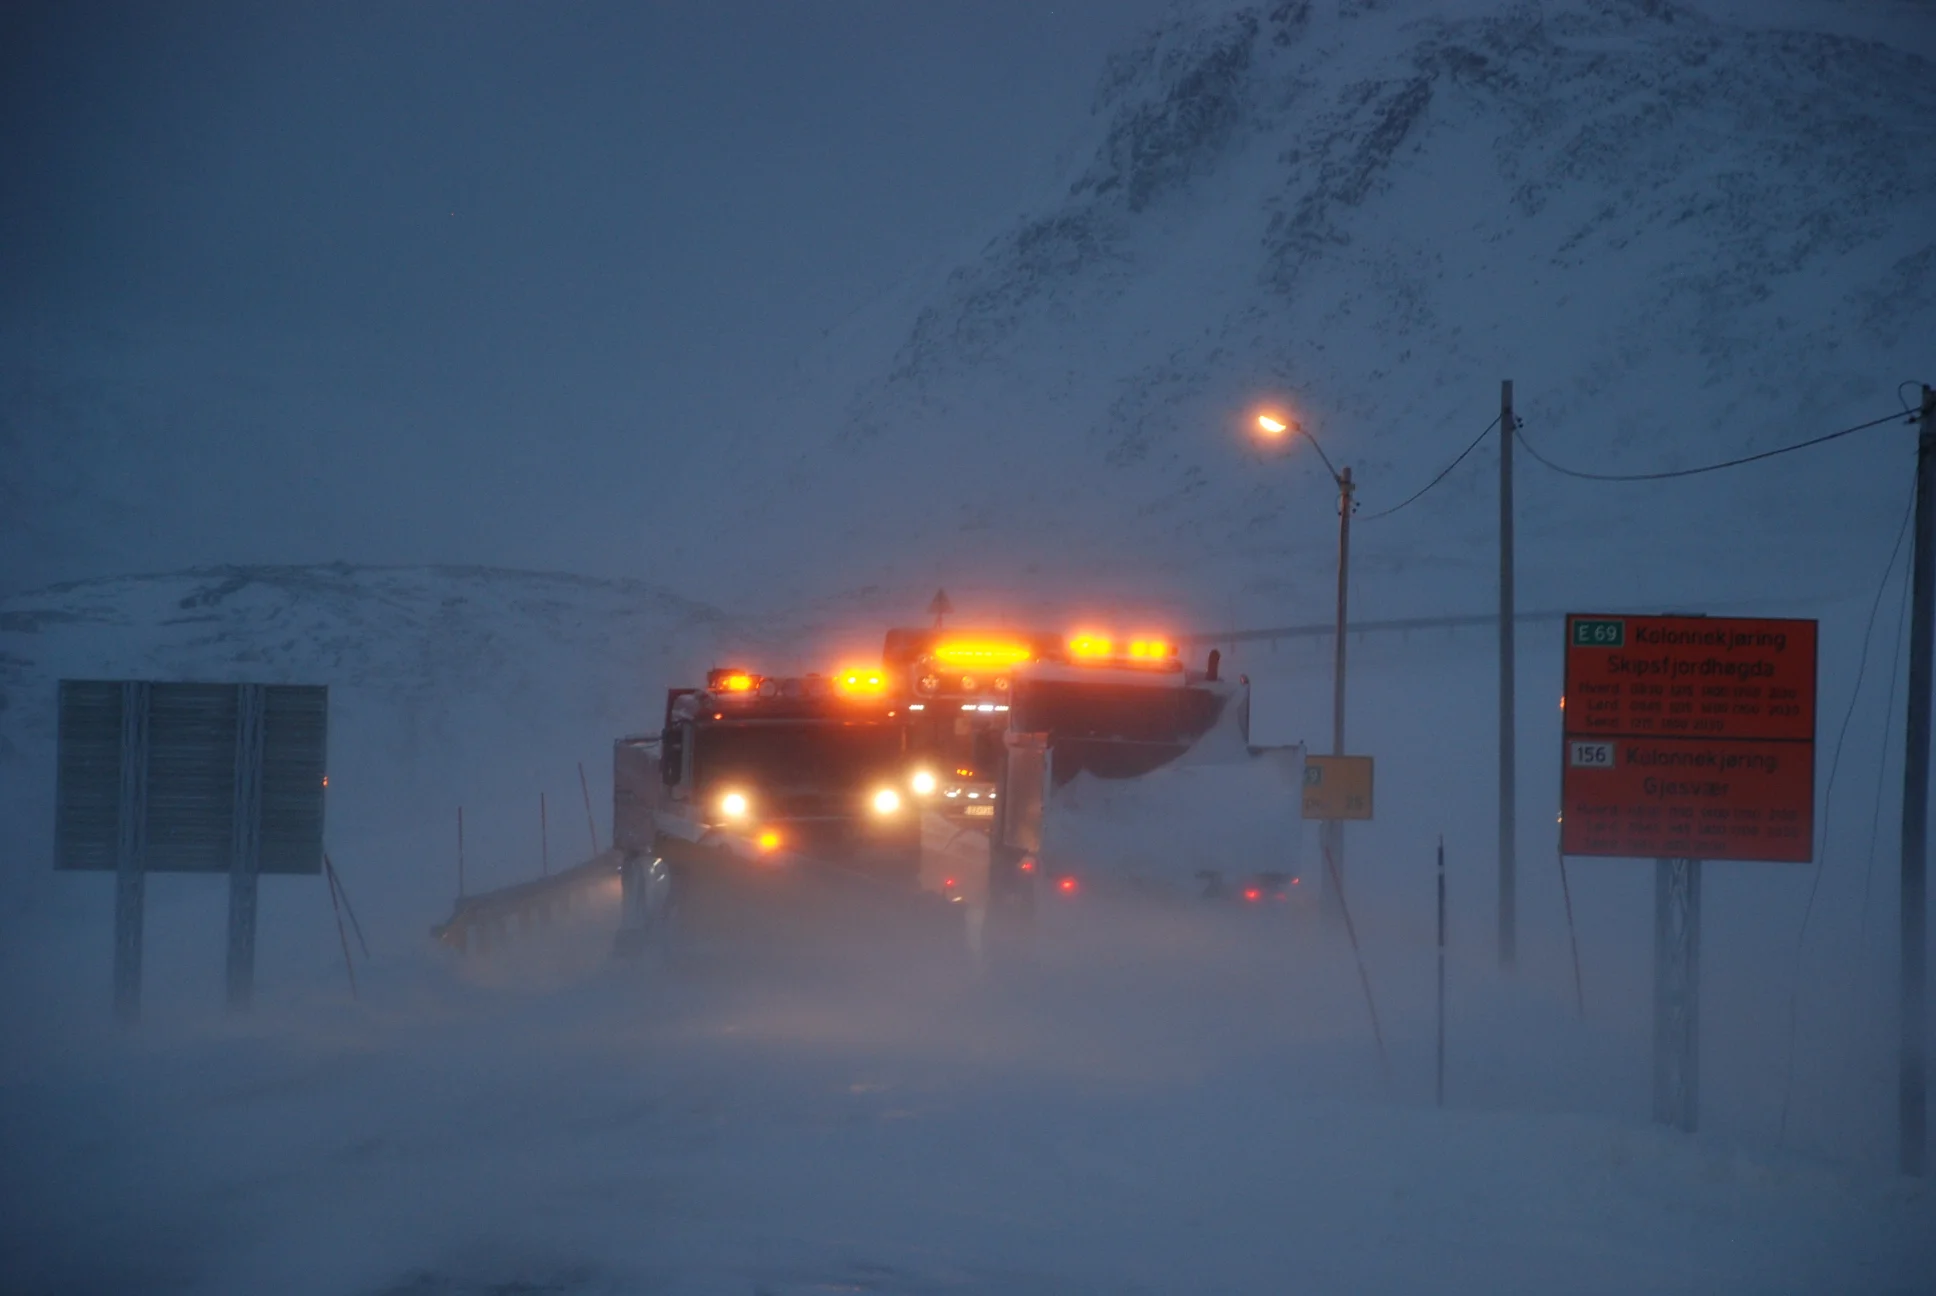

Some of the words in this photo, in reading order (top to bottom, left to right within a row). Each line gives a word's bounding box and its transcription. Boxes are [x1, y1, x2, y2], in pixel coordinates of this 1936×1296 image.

[1578, 625, 1590, 641] E
[1594, 625, 1617, 641] 69
[1636, 626, 1787, 652] Kolonnekjøring
[1578, 746, 1606, 763] 156
